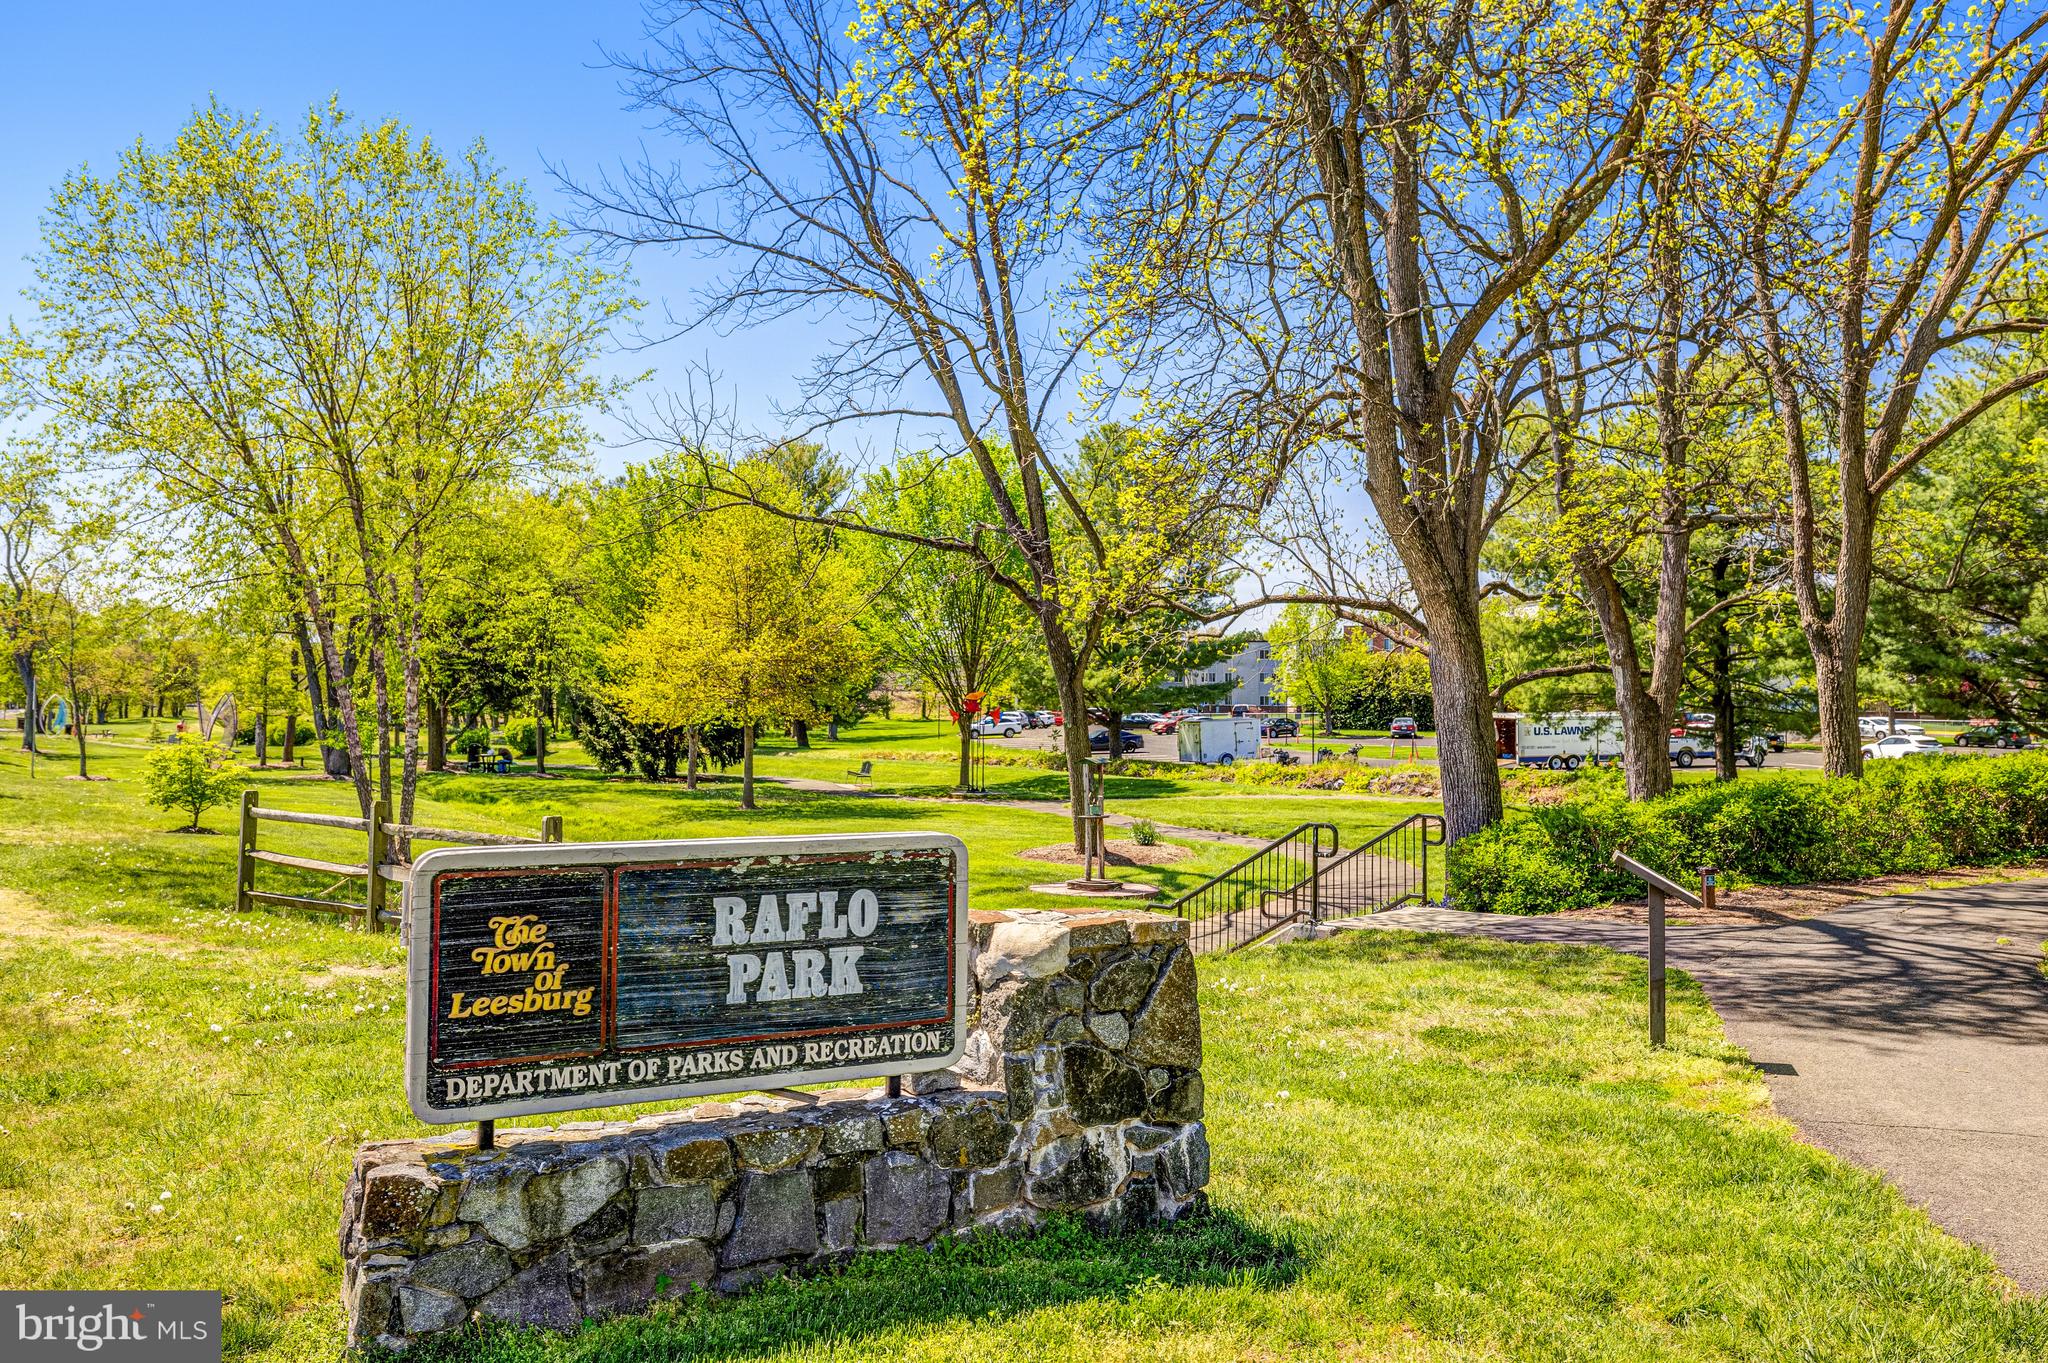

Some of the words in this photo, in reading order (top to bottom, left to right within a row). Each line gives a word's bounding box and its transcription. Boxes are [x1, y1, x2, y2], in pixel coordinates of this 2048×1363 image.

[1533, 726, 1552, 736] U.S.
[1554, 726, 1591, 736] LAWNS
[488, 915, 547, 950] The
[712, 889, 879, 946] RAFLO
[472, 942, 555, 975] Town
[727, 946, 864, 1004] PARK
[534, 963, 569, 991] of
[448, 986, 595, 1019] Leesburg
[446, 1062, 621, 1100] DEPARTMENT
[628, 1058, 661, 1081] OF
[667, 1049, 744, 1077] PARKS
[750, 1046, 798, 1069] AND
[804, 1030, 941, 1064] RECREATION
